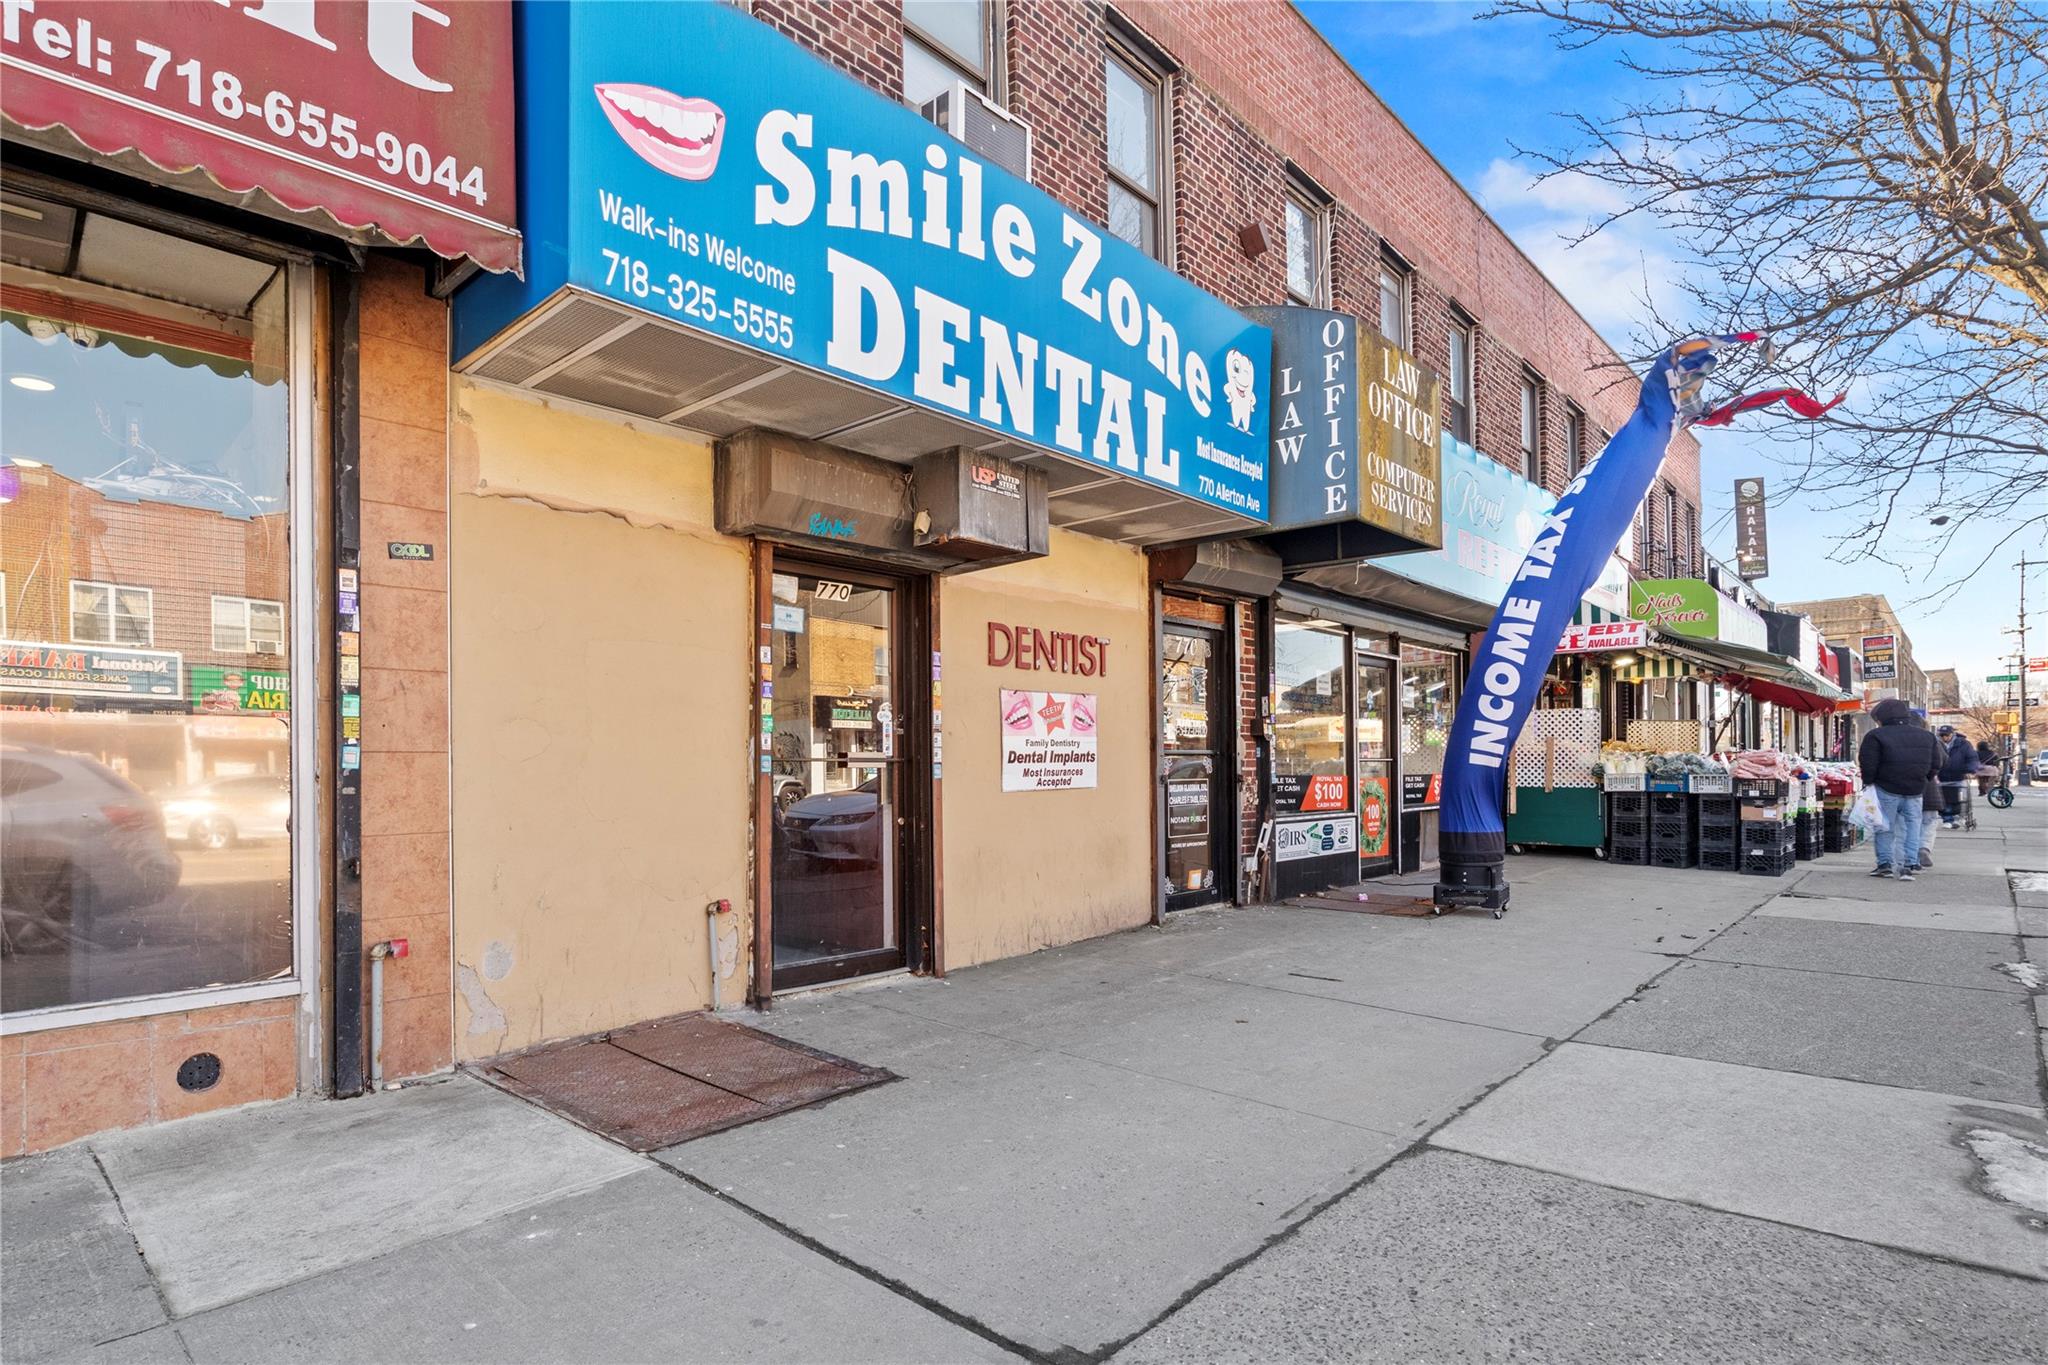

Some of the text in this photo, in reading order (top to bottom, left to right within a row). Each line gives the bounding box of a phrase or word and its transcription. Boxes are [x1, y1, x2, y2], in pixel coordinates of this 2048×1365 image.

[1, 0, 112, 76] Tel:
[136, 39, 487, 206] 718-655-9044
[599, 188, 797, 295] Walk-ins Welcome
[755, 109, 1212, 419] Smile Zone
[601, 248, 794, 350] 718-325-5555
[827, 247, 1180, 487] DENTAL
[1383, 347, 1421, 400] LAW
[1275, 367, 1308, 465] LAW
[1322, 318, 1348, 515] OFFICE
[1368, 381, 1434, 448] OFFICE
[1196, 436, 1263, 482] Most Insurances Accepted
[971, 464, 1020, 486] USP UNITED
[998, 480, 1017, 490] STEEL
[1367, 451, 1435, 503] COMPUTER
[1199, 475, 1261, 513] 770 Allerton Ave
[1371, 481, 1433, 527] SERVICES
[1746, 505, 1757, 557] HALAL
[817, 581, 850, 601] 770
[1636, 591, 1684, 616] Nails
[1588, 622, 1643, 636] EBT
[1649, 608, 1706, 626] Forever
[988, 622, 1111, 677] DENTIST
[1176, 635, 1197, 656] 770
[1468, 505, 1574, 769] INCOME TAX
[1587, 636, 1640, 649] AVAILABLE
[1041, 704, 1062, 717] TEETH
[1007, 750, 1096, 765] Dental Implants
[1025, 739, 1080, 749] Family Dentistry
[1023, 768, 1084, 777] Most Insurances
[1036, 777, 1072, 787] Accepted
[1315, 782, 1343, 801] $100
[1170, 815, 1207, 825] NOTARY PUBLIC
[1290, 829, 1307, 846] IRS
